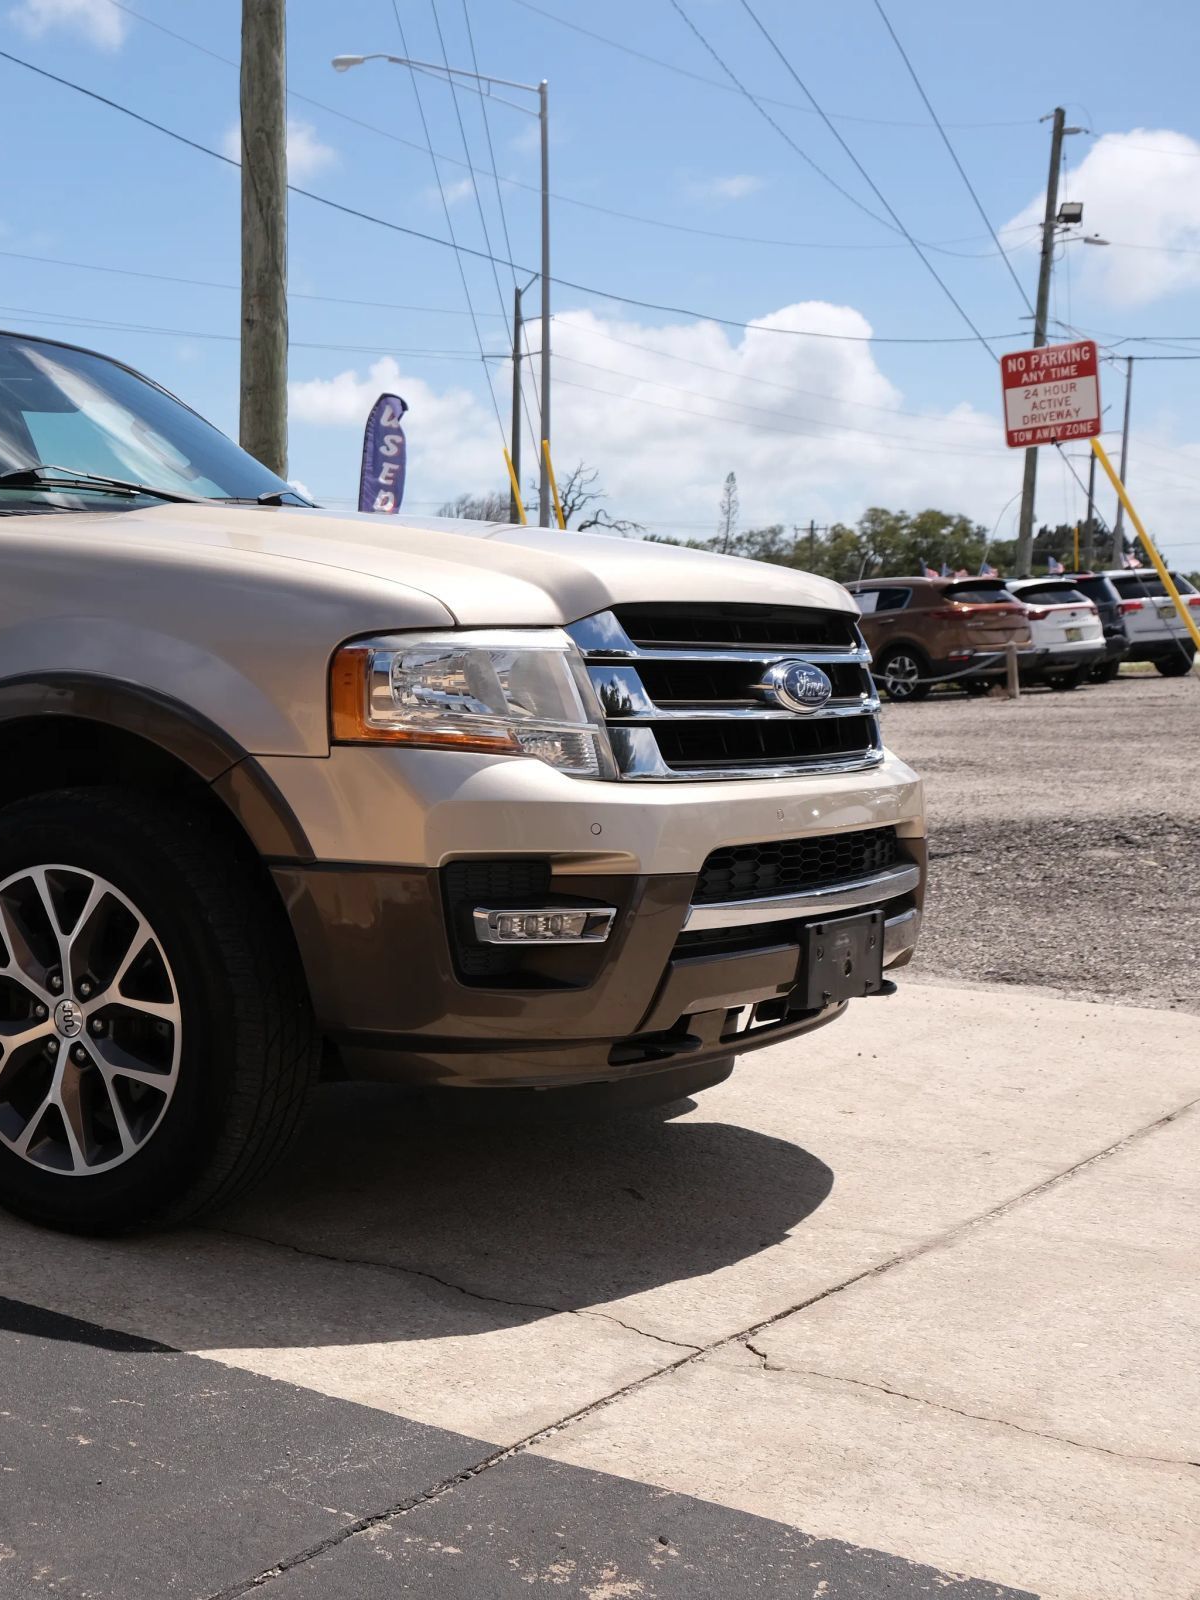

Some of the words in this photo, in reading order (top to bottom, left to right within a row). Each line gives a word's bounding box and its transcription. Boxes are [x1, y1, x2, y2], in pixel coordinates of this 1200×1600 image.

[1007, 357, 1026, 373] NO
[1031, 346, 1090, 369] PARKING
[1021, 369, 1046, 384] ANY
[1050, 364, 1078, 379] TIME
[1024, 388, 1039, 400] 24
[1043, 382, 1078, 396] HOUR
[1031, 395, 1072, 411] ACTIVE
[1022, 407, 1081, 425] DRIVEWAY
[1013, 430, 1033, 443] TOW
[1036, 426, 1066, 439] AWAY
[1066, 421, 1094, 436] ZONE
[795, 669, 829, 697] Ford
